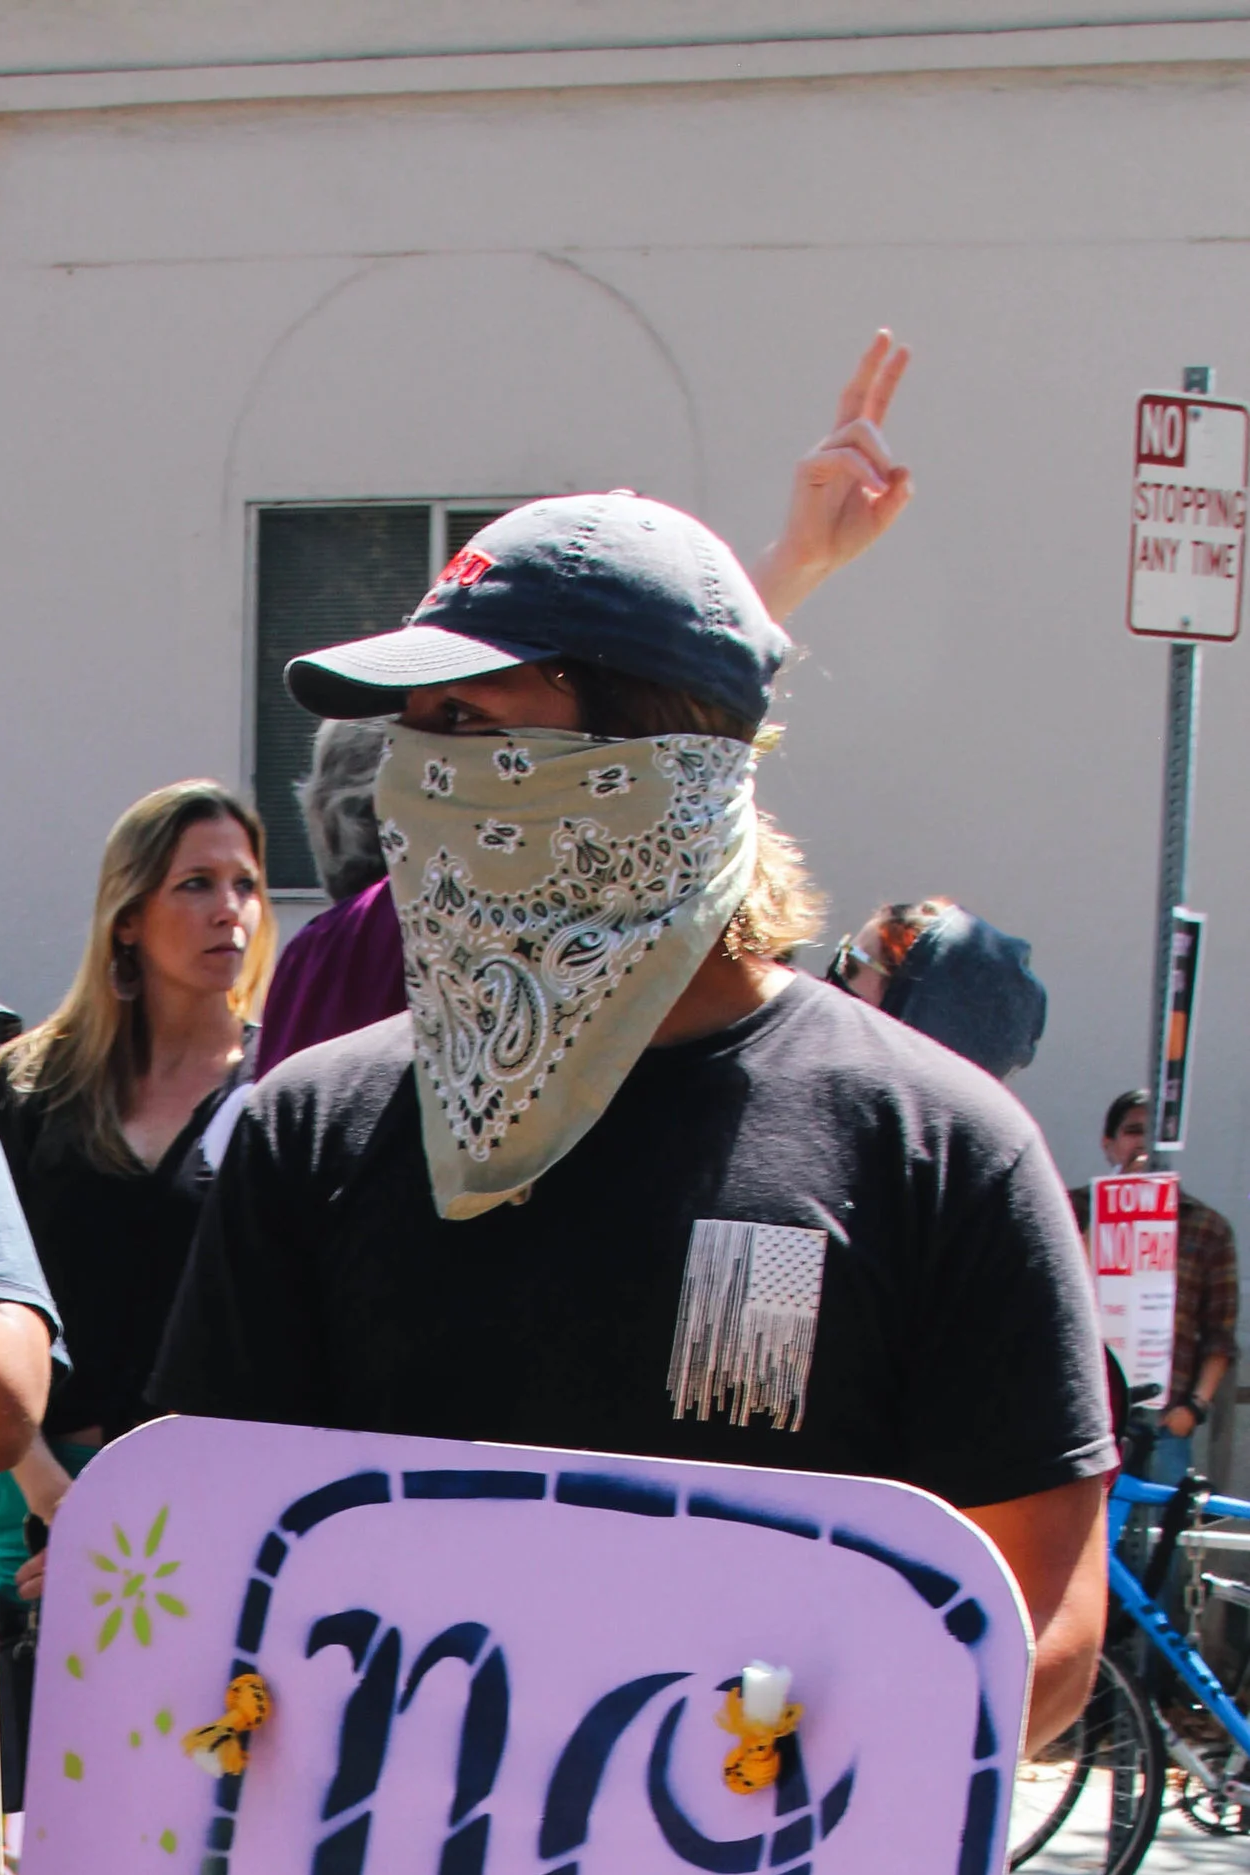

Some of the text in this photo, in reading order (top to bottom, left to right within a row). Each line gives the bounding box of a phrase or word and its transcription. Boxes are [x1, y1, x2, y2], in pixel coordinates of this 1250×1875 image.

[1140, 403, 1183, 459] NO
[1134, 481, 1246, 530] STOPPING
[1136, 536, 1236, 579] ANY TIME
[1104, 1183, 1159, 1214] TOW
[1099, 1222, 1130, 1269] NO
